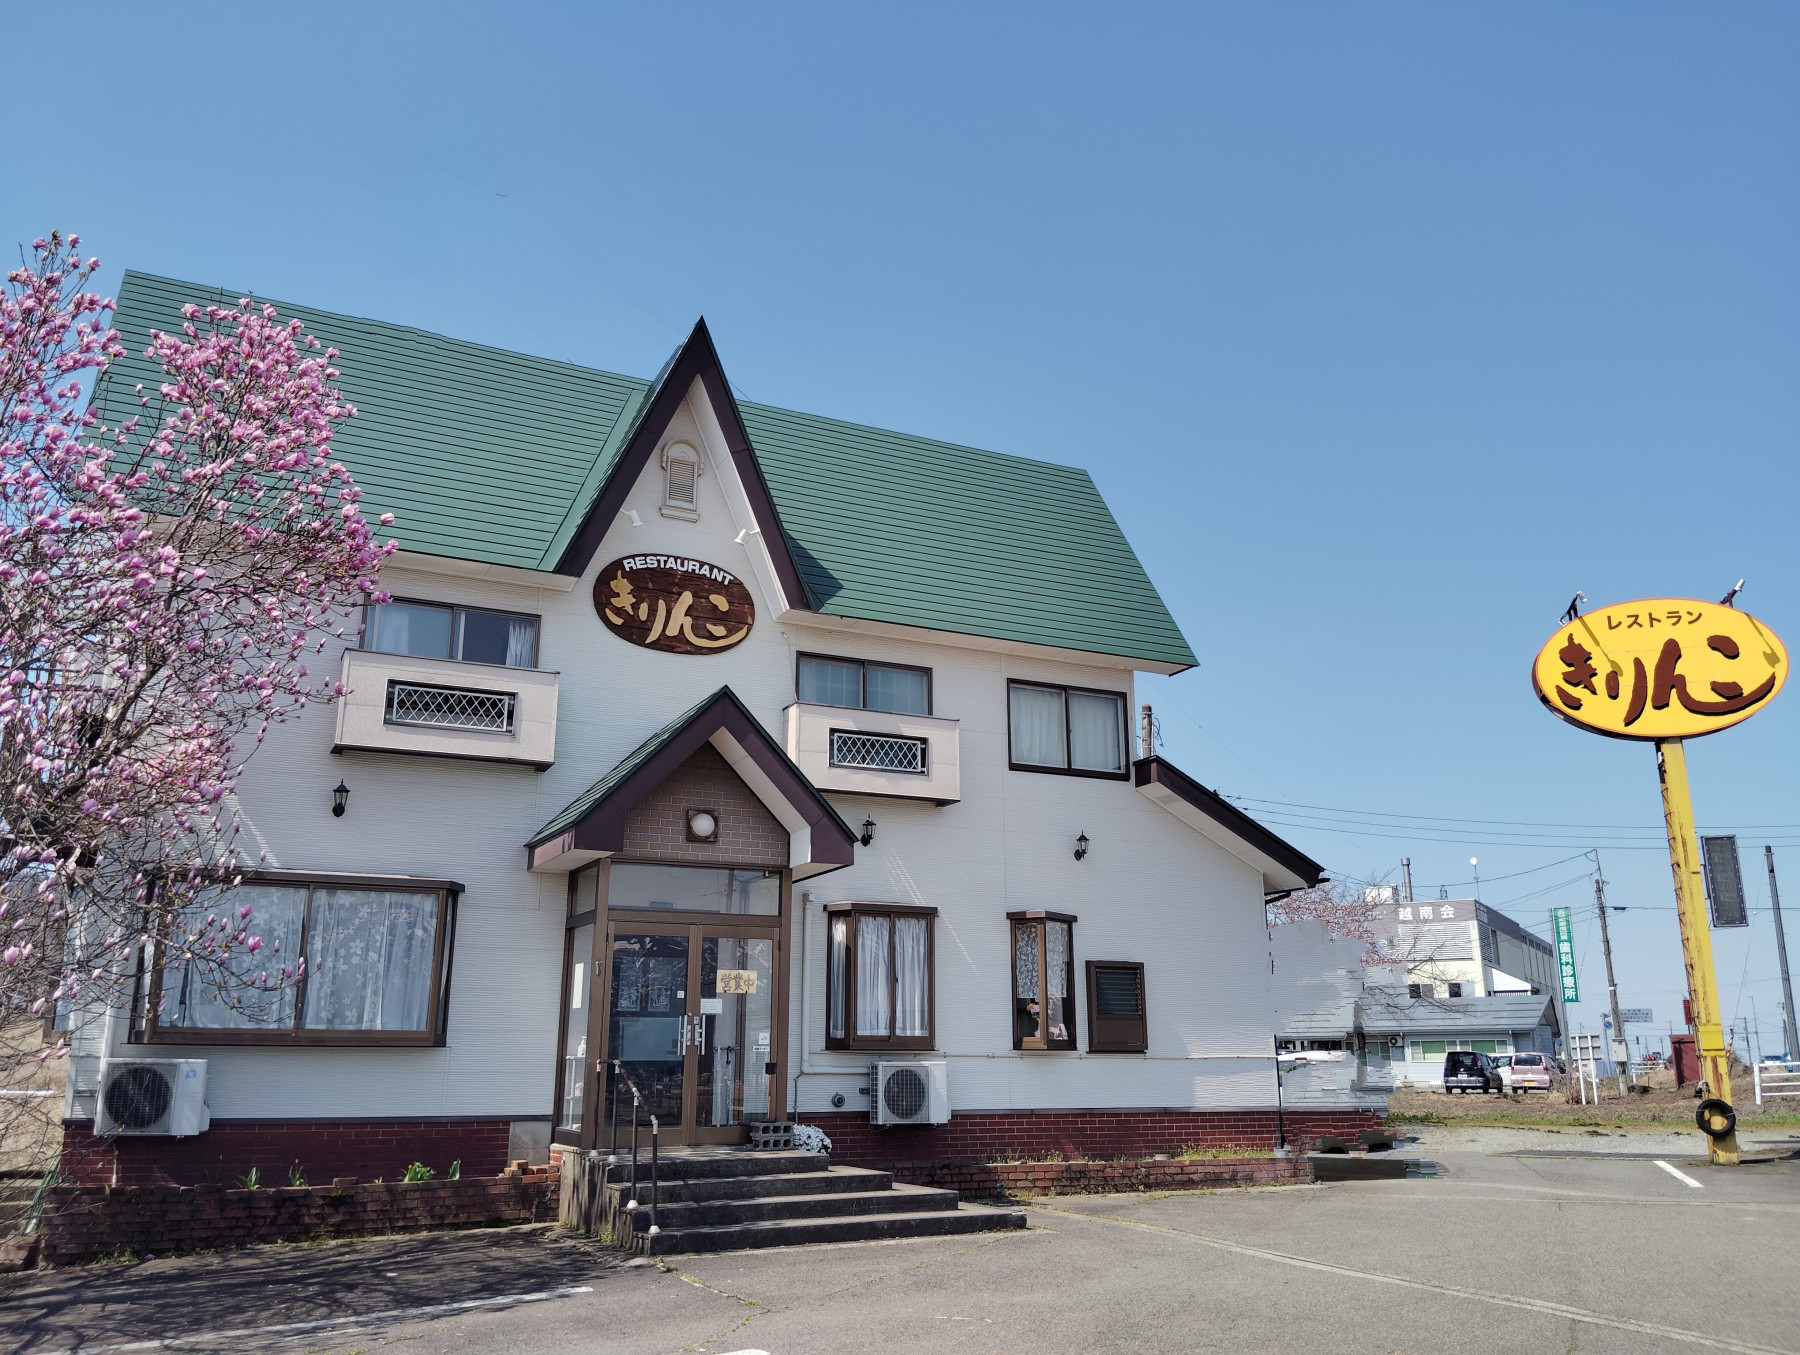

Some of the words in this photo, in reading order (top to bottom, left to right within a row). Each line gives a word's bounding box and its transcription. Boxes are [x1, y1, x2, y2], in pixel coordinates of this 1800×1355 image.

[623, 556, 734, 586] RESTAURANT
[1606, 610, 1703, 630] レストラン
[720, 972, 756, 992] 営業中
[1558, 941, 1577, 1000] 歯科診療所
